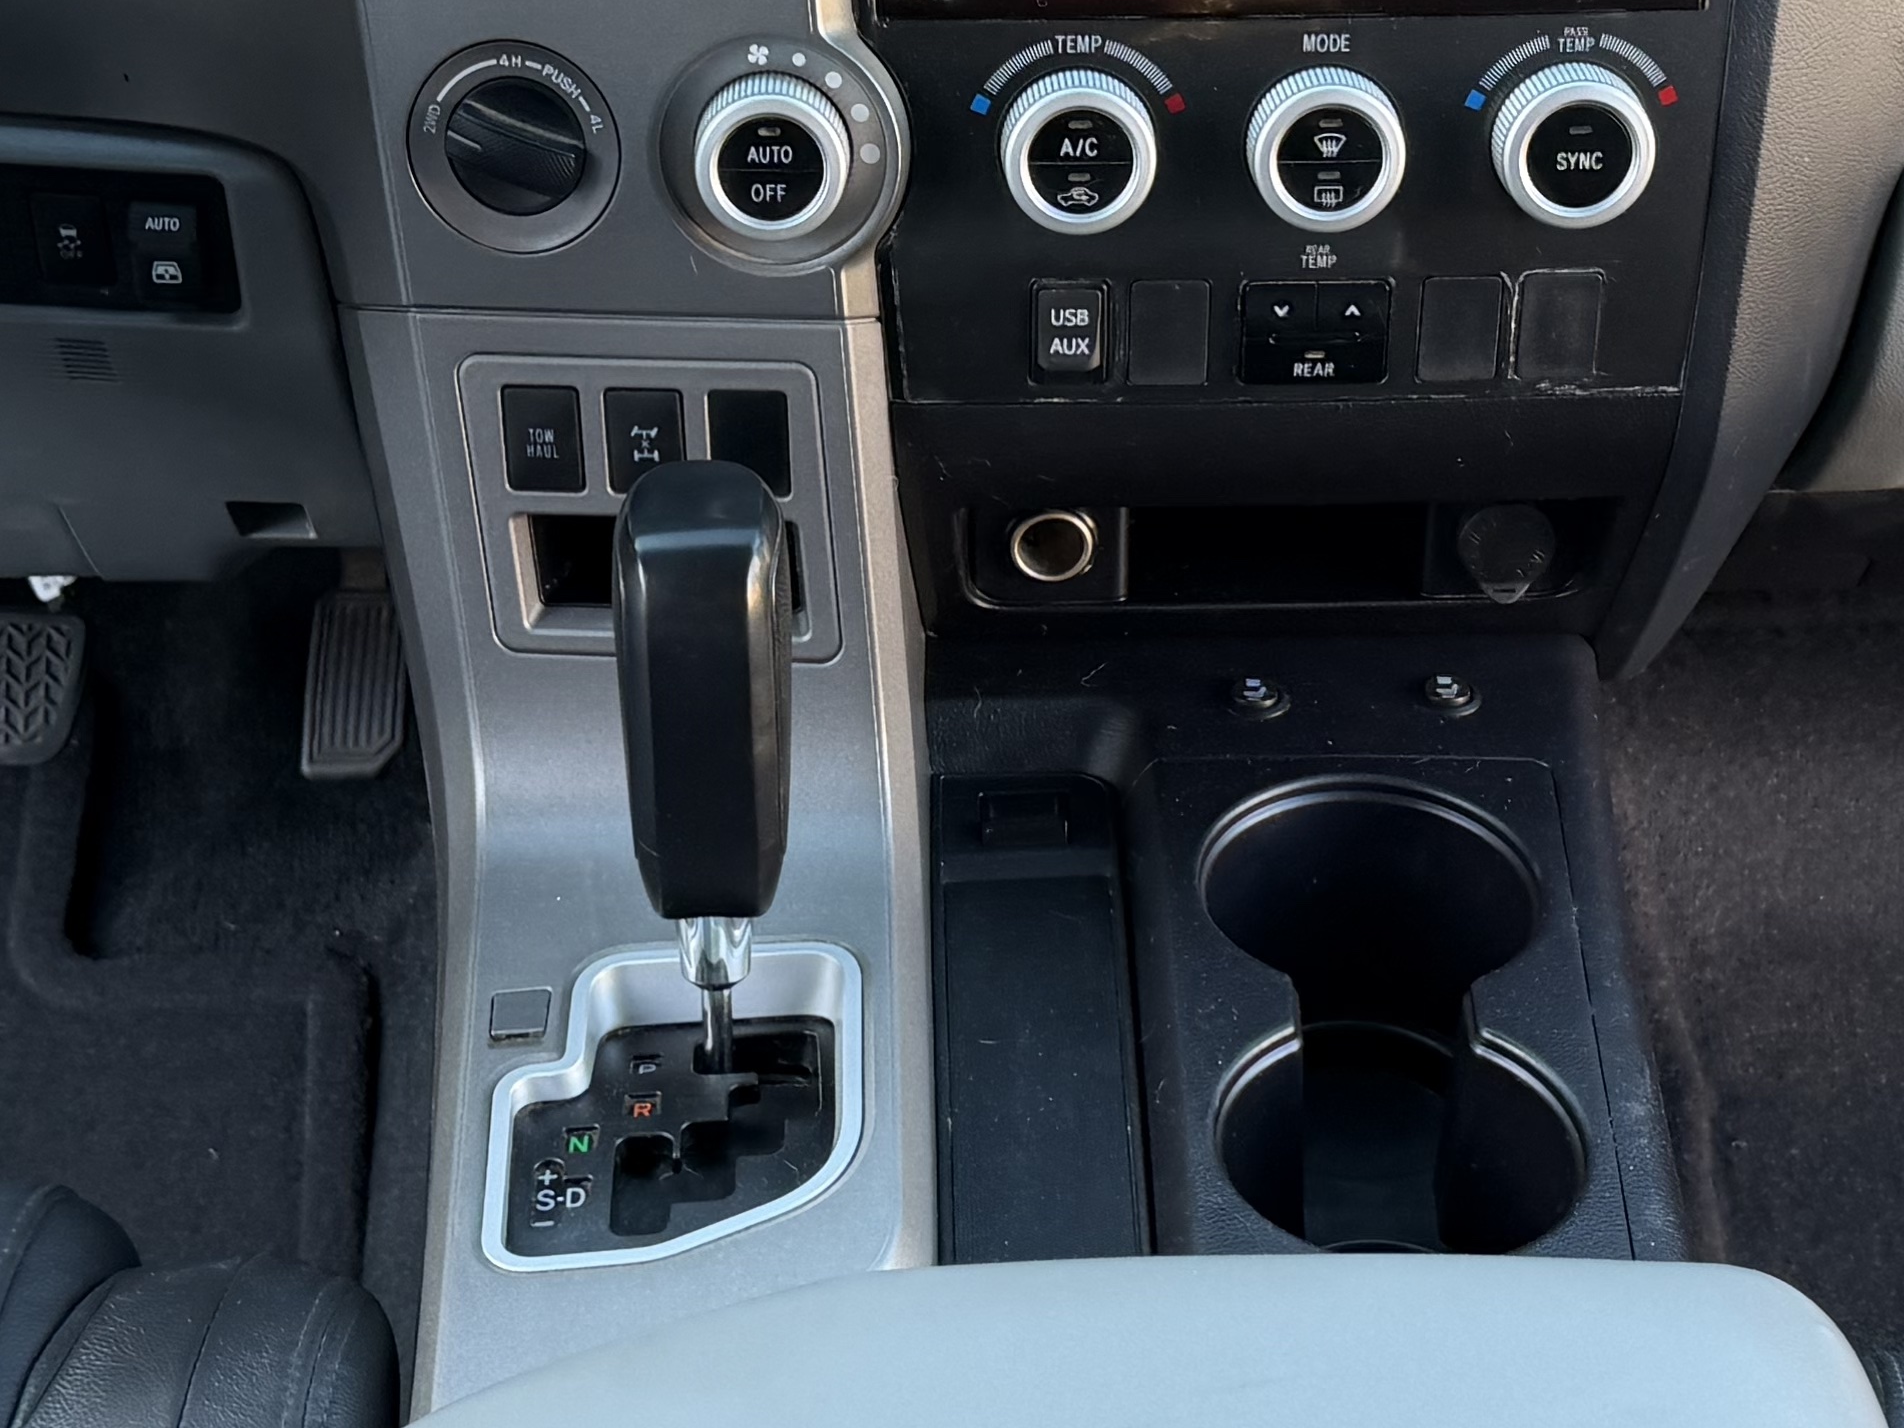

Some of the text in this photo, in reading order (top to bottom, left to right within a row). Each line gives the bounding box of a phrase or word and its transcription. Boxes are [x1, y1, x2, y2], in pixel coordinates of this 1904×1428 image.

[1054, 34, 1103, 54] TEMP
[1302, 33, 1351, 53] MODE
[1557, 36, 1596, 53] TEMP
[541, 63, 582, 100] PUSH
[423, 103, 441, 135] 2WD
[589, 113, 604, 135] 4L
[746, 144, 794, 164] AUTO
[1059, 136, 1099, 158] A/C
[1555, 151, 1604, 171] SYNC
[750, 183, 787, 203] OFF
[145, 216, 181, 233] AUTO
[1300, 254, 1338, 269] TEMP
[1049, 308, 1090, 327] USB
[1049, 337, 1091, 356] AUX
[1292, 362, 1336, 378] REAR
[527, 427, 555, 444] TOW
[526, 443, 560, 460] HAUL
[632, 1102, 652, 1119] R
[567, 1135, 590, 1154] N
